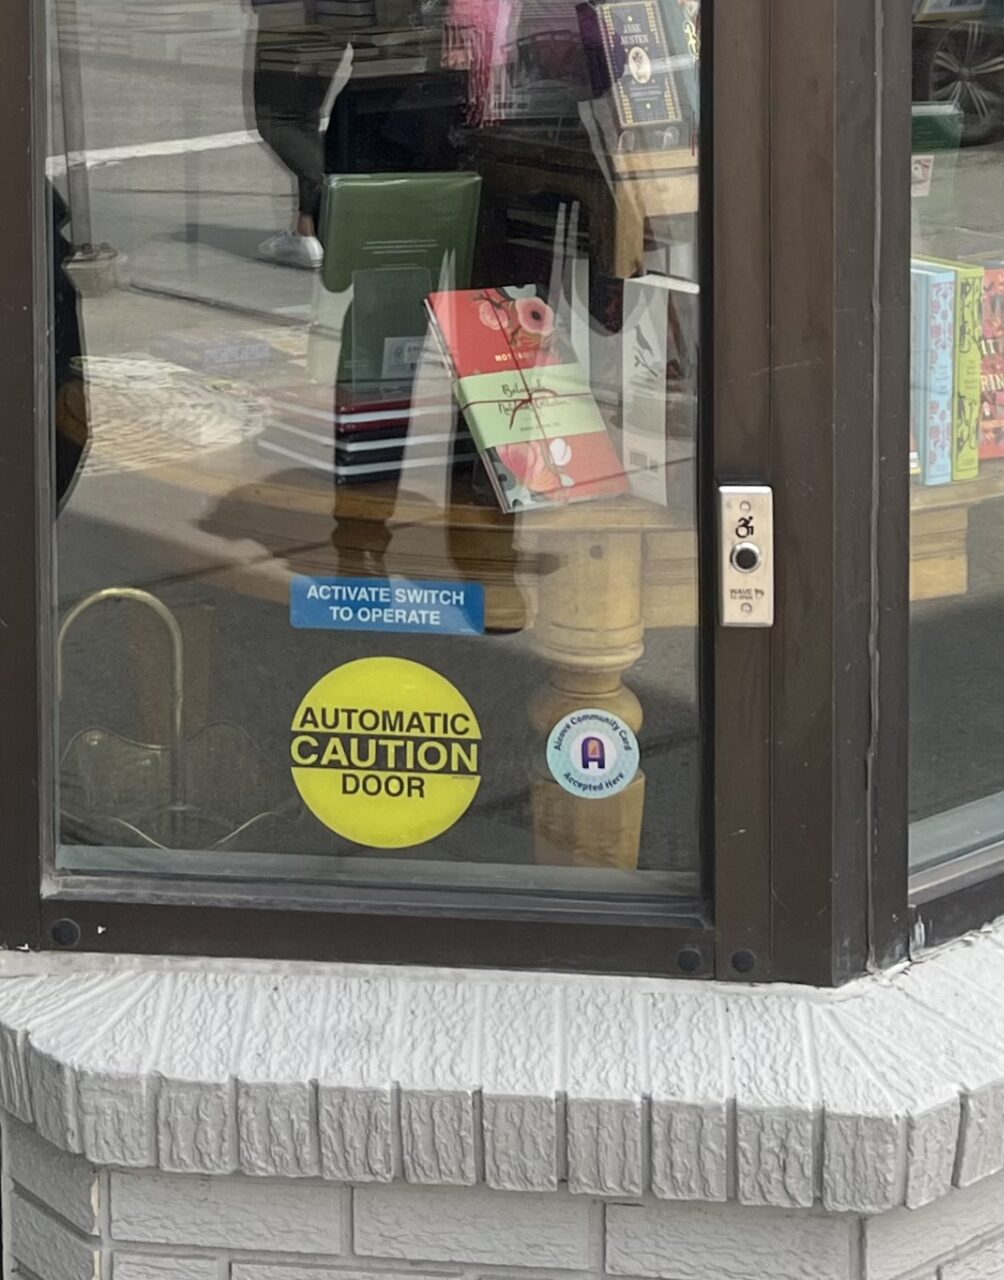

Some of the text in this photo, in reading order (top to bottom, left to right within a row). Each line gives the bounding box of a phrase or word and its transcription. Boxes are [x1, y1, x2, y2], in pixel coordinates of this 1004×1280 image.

[623, 23, 642, 33] JANE
[620, 34, 649, 46] AUSTEN
[307, 584, 465, 606] ACTIVATE SWITCH
[330, 606, 440, 625] TO OPERATE
[300, 706, 470, 735] AUTOMATIC
[553, 714, 633, 751] Alcove Community Card
[290, 734, 478, 773] CAUTION
[341, 773, 425, 799] DOOR
[563, 772, 624, 791] Accepted Here
